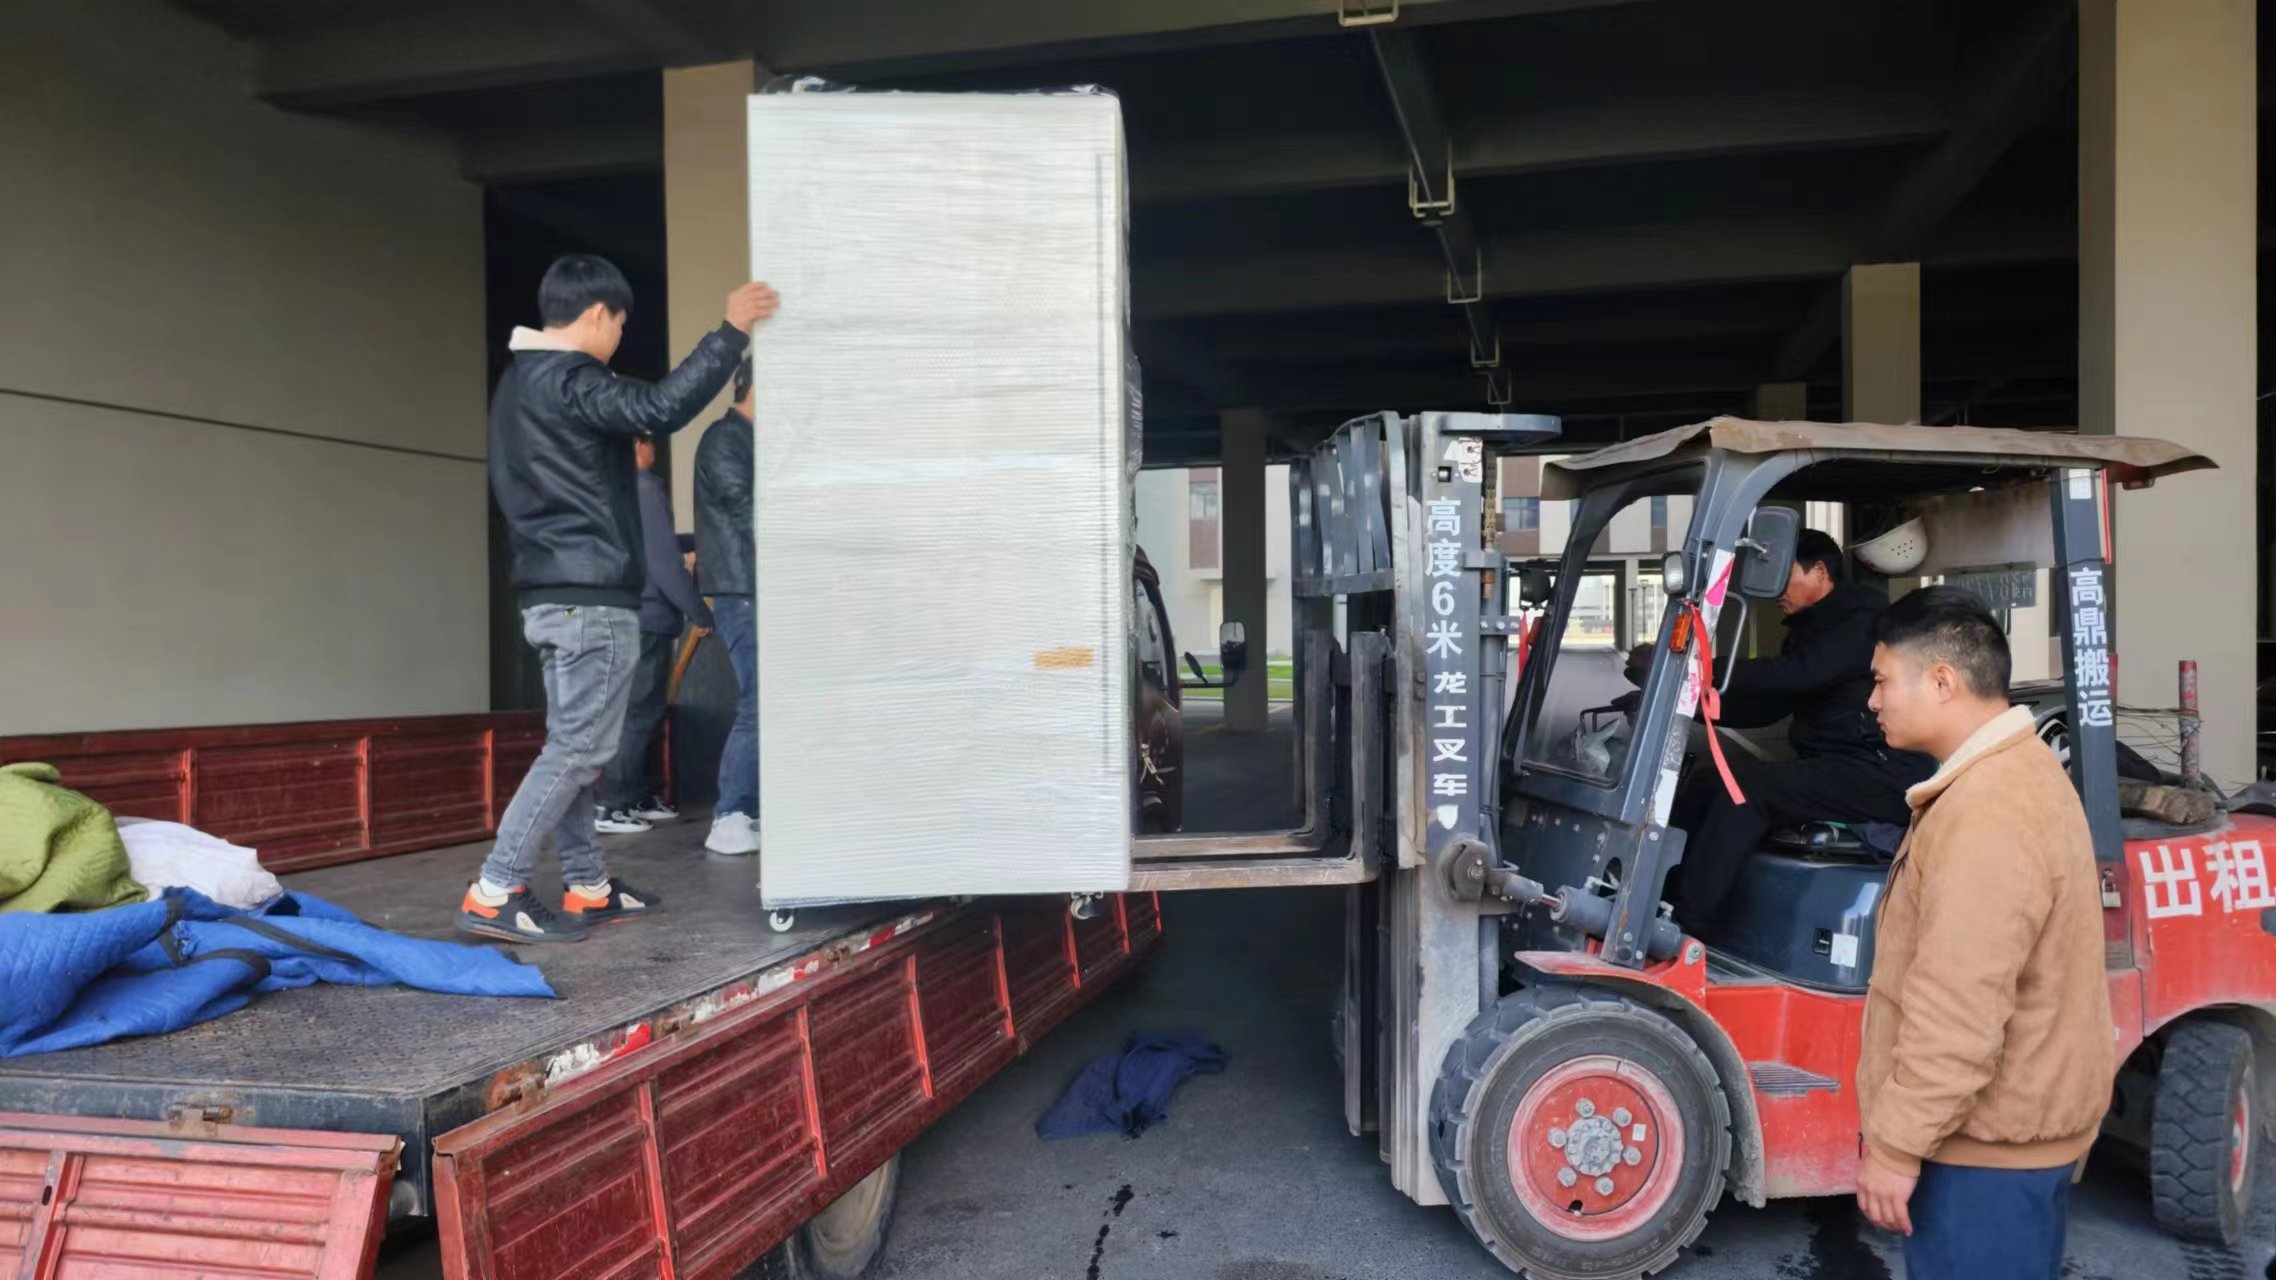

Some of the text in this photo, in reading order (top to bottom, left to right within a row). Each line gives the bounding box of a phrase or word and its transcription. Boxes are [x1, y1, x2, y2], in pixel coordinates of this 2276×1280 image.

[1425, 496, 1468, 797] 高度6米 龙工叉车
[2070, 566, 2113, 728] 高鼎搬运
[2139, 840, 2276, 919] 出租
